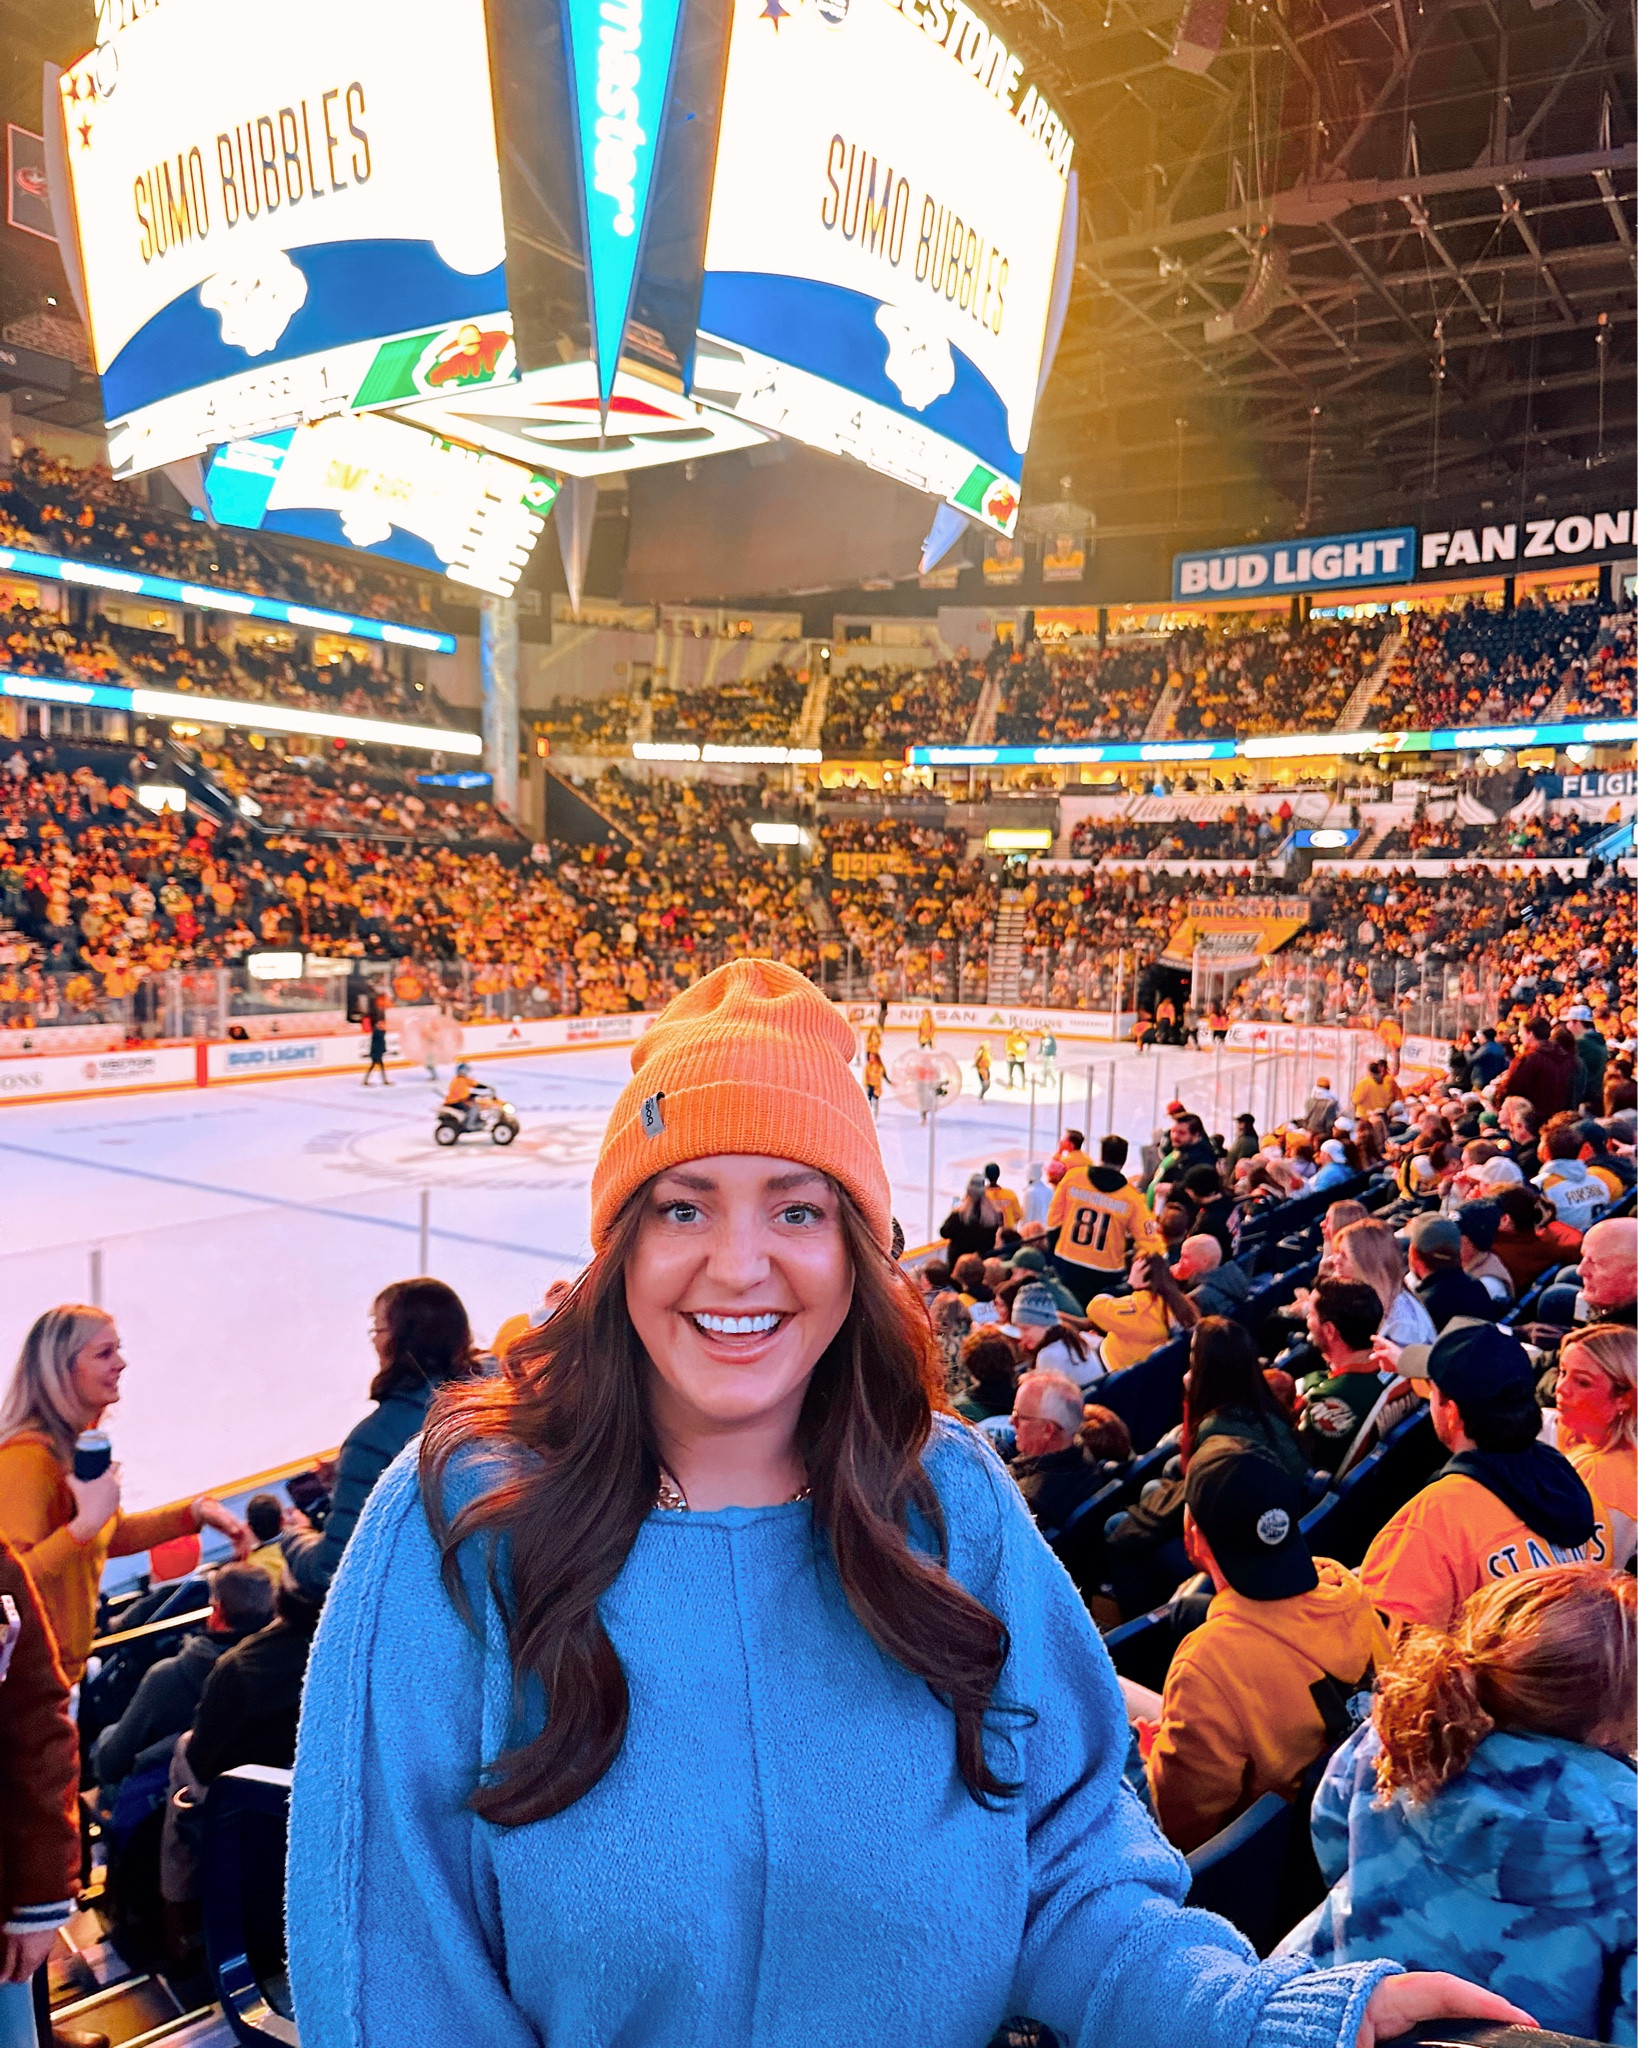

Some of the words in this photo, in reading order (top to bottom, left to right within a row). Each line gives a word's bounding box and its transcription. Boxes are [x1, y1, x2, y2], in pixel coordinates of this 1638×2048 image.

[1015, 84, 1075, 179] ARENA
[134, 145, 210, 266] SUMO
[216, 81, 371, 229] BUBBLES
[822, 134, 910, 268] SUMO
[915, 193, 1009, 336] BUBBLES
[1180, 553, 1268, 595] BUD
[1273, 537, 1405, 585] LIGHT
[1421, 523, 1517, 569] FAN
[899, 1009, 976, 1022] NISAN
[1070, 1207, 1112, 1252] 81
